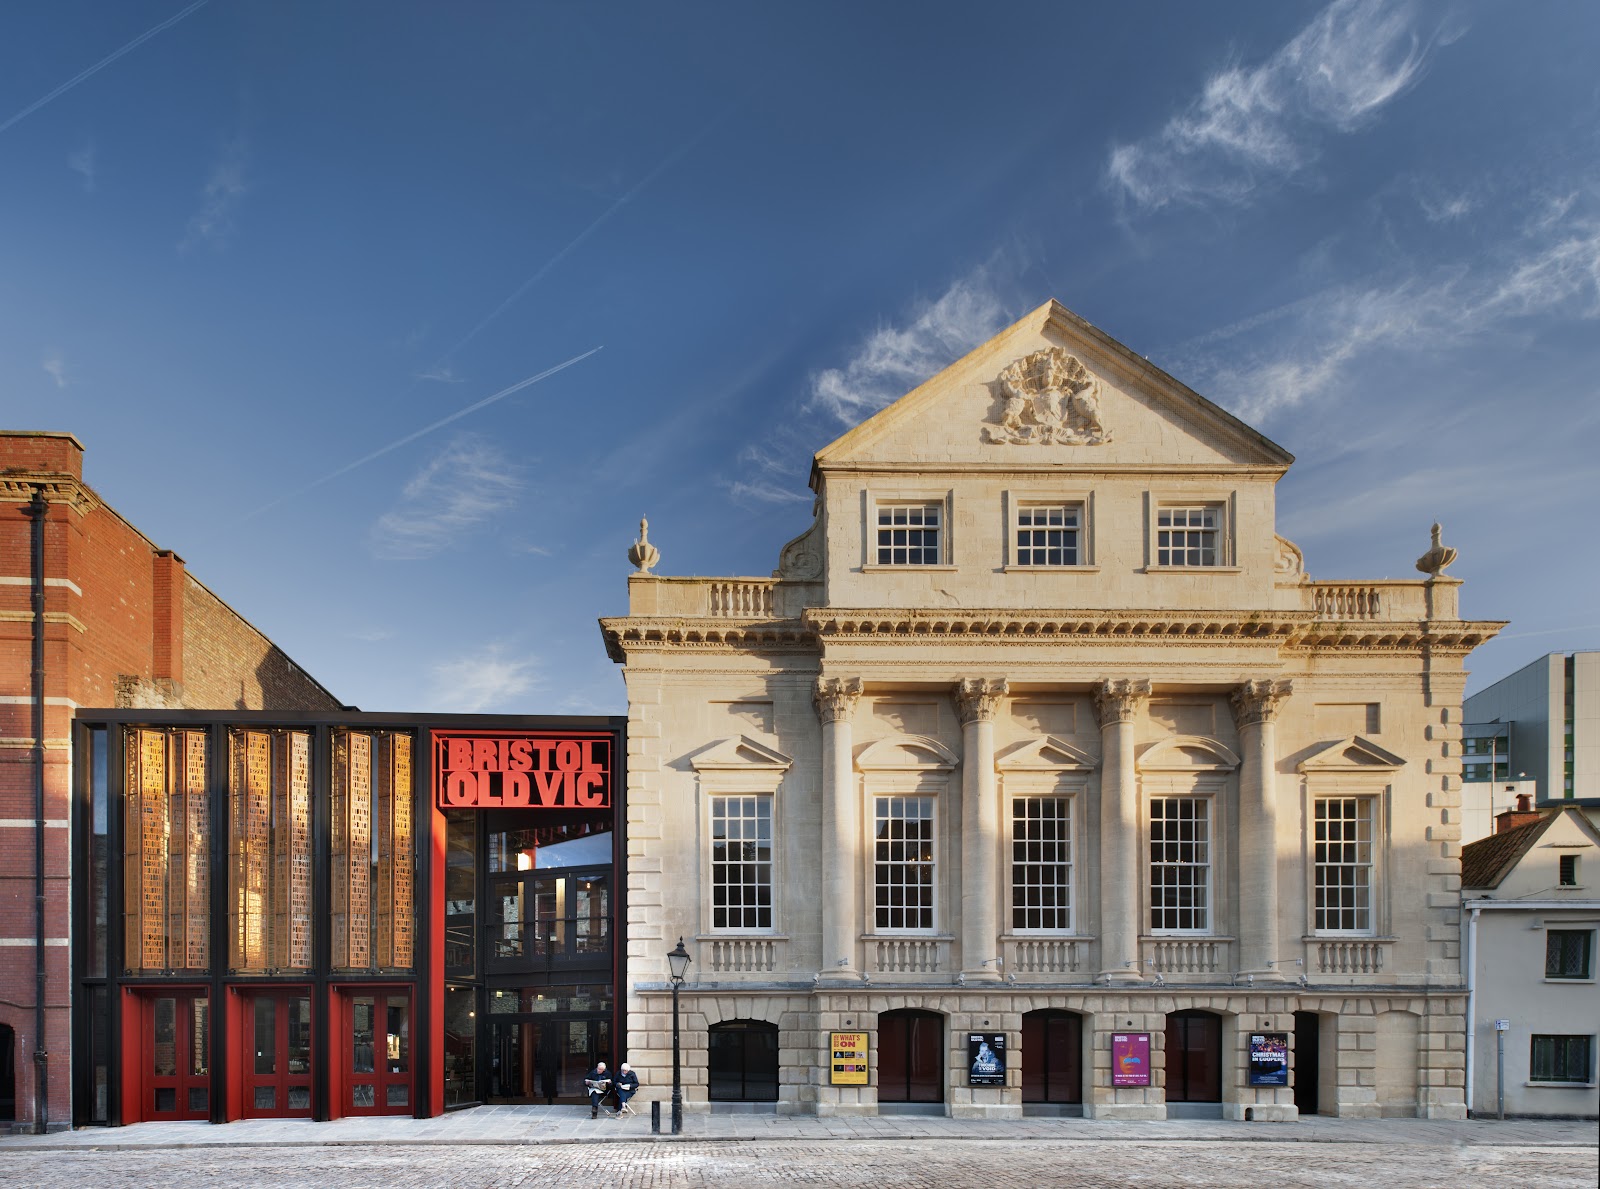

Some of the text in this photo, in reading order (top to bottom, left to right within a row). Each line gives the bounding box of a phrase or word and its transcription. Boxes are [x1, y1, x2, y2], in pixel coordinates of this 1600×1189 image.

[448, 740, 603, 771] BRISTOL
[447, 771, 604, 806] OLD VIC
